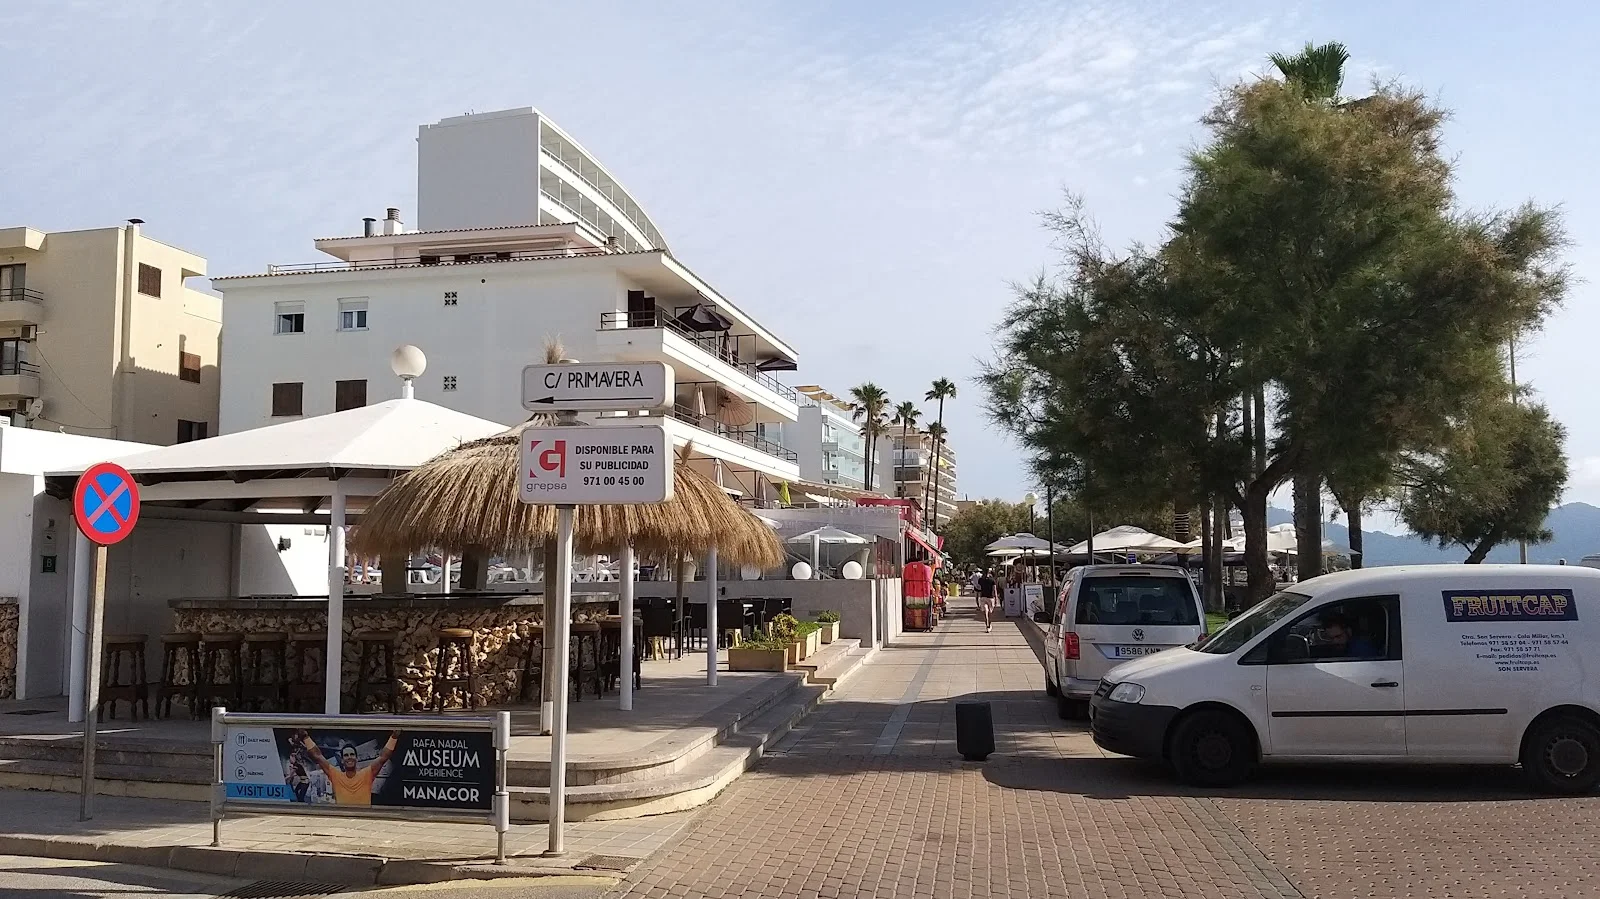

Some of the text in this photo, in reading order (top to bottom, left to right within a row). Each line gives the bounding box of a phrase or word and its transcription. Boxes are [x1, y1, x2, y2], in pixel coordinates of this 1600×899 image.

[544, 370, 644, 389] C/ PRIMAVERA
[575, 445, 655, 455] DISPONIBLE PARA
[579, 460, 649, 470] SU PUBLICIDAD
[583, 476, 645, 486] 971 00 45 00
[526, 482, 567, 493] grepsa
[46, 558, 53, 568] B
[1451, 595, 1568, 616] FRUITCAP
[1120, 647, 1143, 656] 9586
[413, 739, 469, 749] RAFA NADAL
[402, 749, 480, 768] MUSEUM
[419, 768, 463, 778] XPERIENCE
[237, 785, 284, 798] VISIT US!
[403, 785, 479, 802] MANACOR
